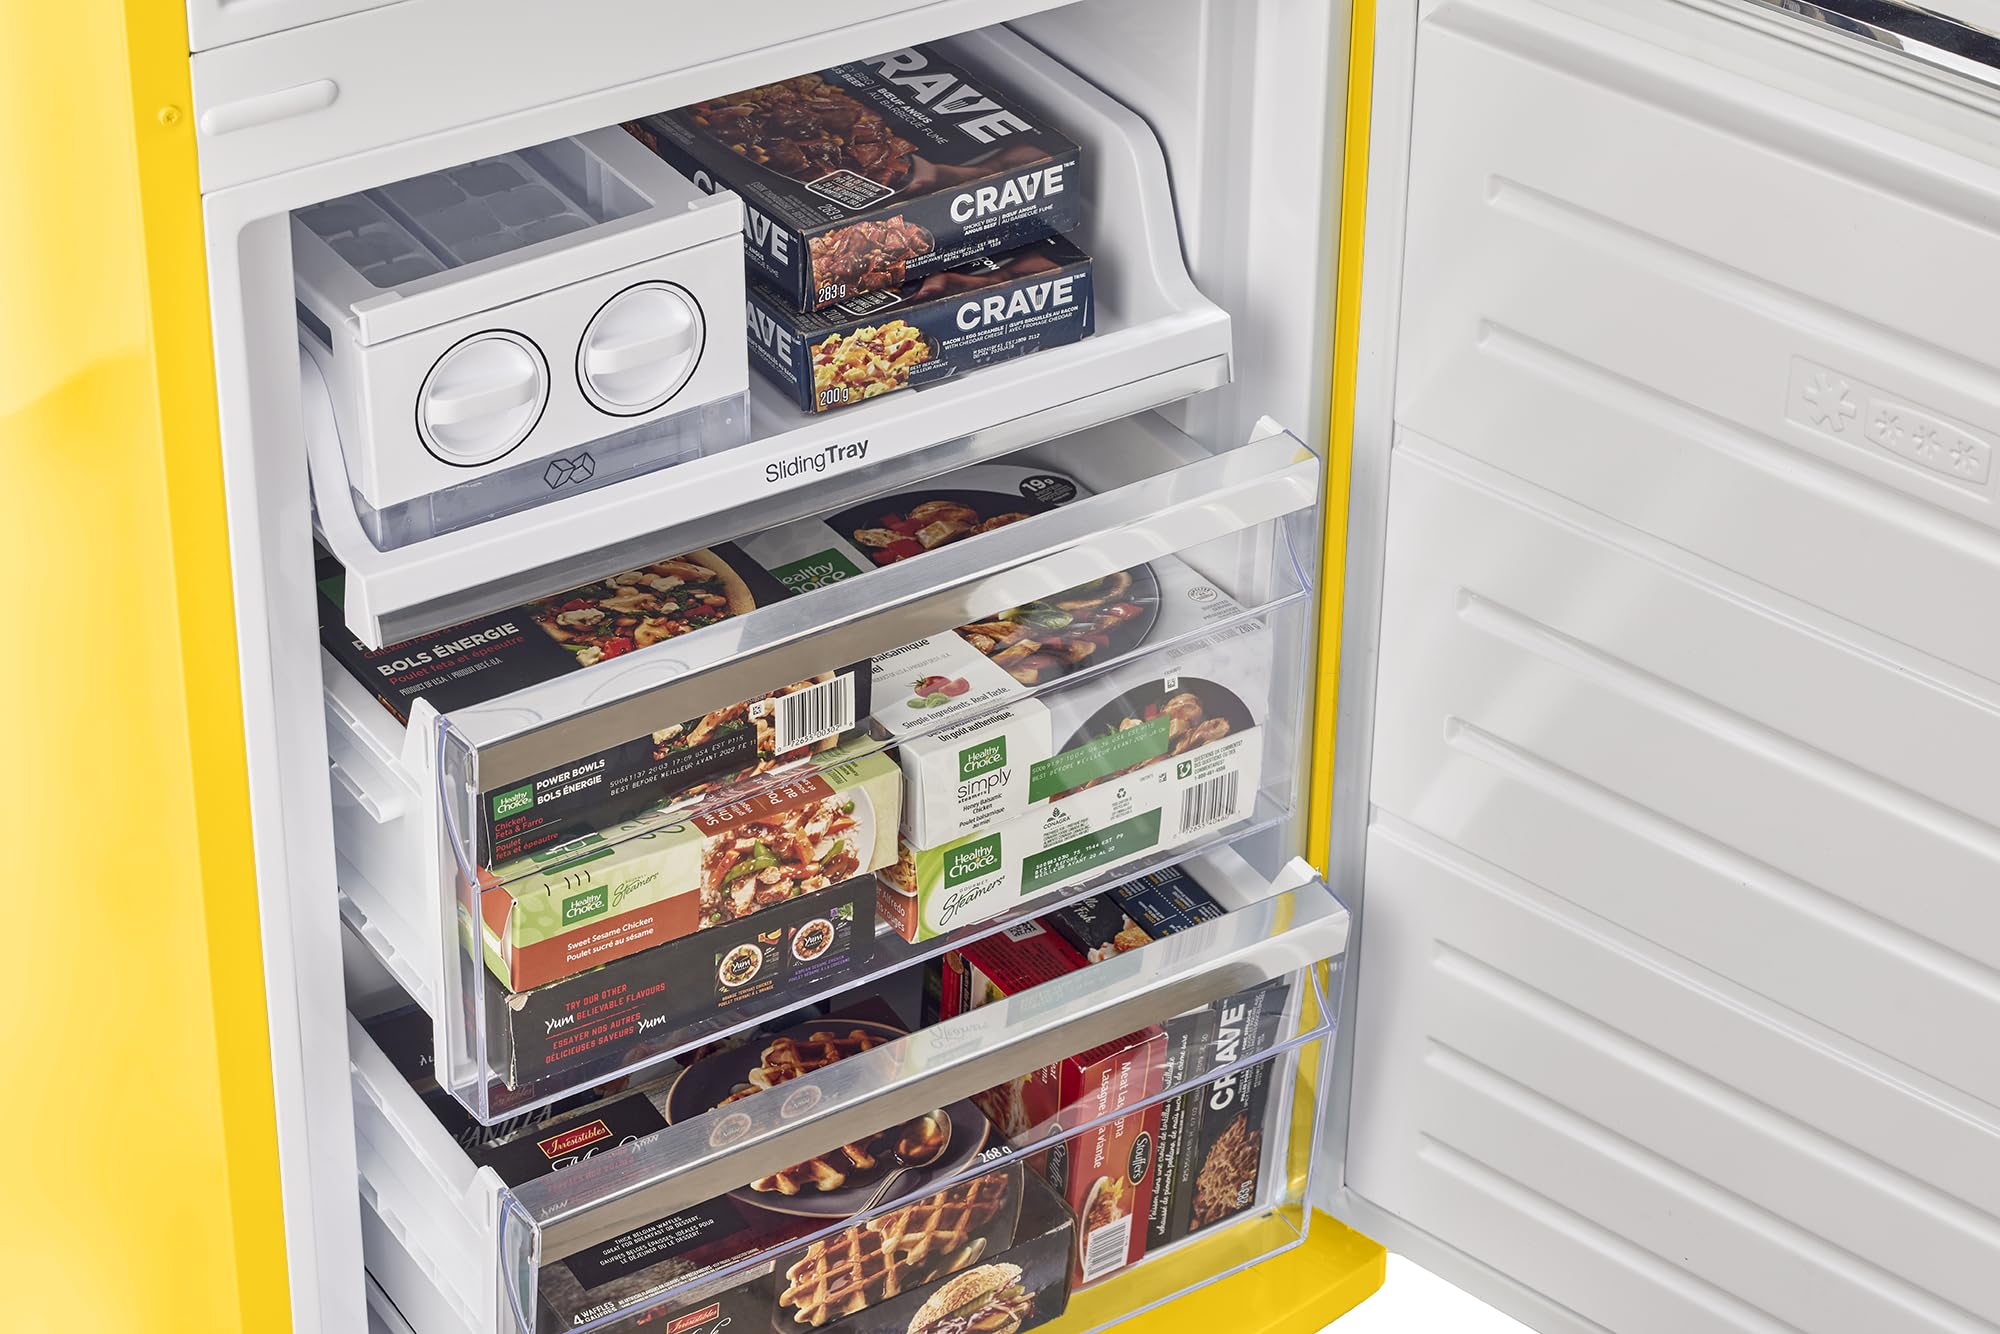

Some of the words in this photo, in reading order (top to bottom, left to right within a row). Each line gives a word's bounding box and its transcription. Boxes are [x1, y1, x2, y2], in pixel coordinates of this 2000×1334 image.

[841, 73, 867, 90] BEEF
[900, 104, 933, 125] ANGUS
[950, 164, 1064, 223] CRAVE
[818, 285, 837, 303] 283
[956, 276, 1074, 331] CRAVE
[942, 337, 961, 347] BACON
[965, 334, 977, 343] EGG
[820, 388, 840, 407] 200
[765, 439, 869, 483] SlidingTray
[376, 651, 433, 677] BOLS
[432, 622, 520, 660] ÉNERGIE
[388, 668, 430, 686] Poulet
[431, 660, 456, 674] feta
[457, 655, 471, 665] et
[471, 634, 526, 659] épeautre
[400, 682, 426, 697] PRODUCT
[902, 713, 929, 730] Simple
[929, 700, 973, 722] Ingredients.
[971, 693, 989, 706] Real
[989, 686, 1011, 699] Taste.
[938, 733, 947, 743] Un
[949, 726, 969, 741] goût
[711, 741, 726, 753] EST
[967, 745, 1000, 764] Healthy
[963, 753, 1001, 773] Choice
[536, 772, 570, 791] POWER
[572, 759, 606, 778] BOWLS
[610, 784, 630, 797] BEST
[632, 775, 659, 791] BEFORE
[957, 768, 1012, 799] simply
[500, 791, 528, 805] Healthy
[537, 790, 562, 805] BOLS
[563, 775, 602, 796] ÉNERGIE
[497, 797, 529, 814] Choice
[963, 802, 980, 812] Honey
[980, 793, 1003, 807] Balsamic
[972, 803, 993, 815] Chicken
[495, 816, 526, 833] Chicken
[495, 828, 513, 840] Feta
[522, 817, 544, 830] Farro
[959, 817, 976, 828] Poulet
[976, 807, 1005, 821] balsamique
[1043, 816, 1070, 830] CONAGRA
[495, 838, 521, 853] Poulet
[495, 849, 512, 861] feta
[523, 832, 559, 850] épeautre
[955, 845, 993, 866] Healthy
[949, 854, 994, 878] Choice
[571, 893, 602, 910] Healthy
[612, 873, 656, 908] Steamers
[939, 878, 1000, 926] Steamers
[566, 902, 603, 919] Choice
[1074, 904, 1097, 924] Fish
[566, 947, 591, 963] Poulet
[592, 939, 614, 954] sucré
[615, 937, 625, 946] au
[625, 926, 654, 943] sésame
[567, 939, 590, 952] Sweet
[591, 927, 621, 944] Sesame
[622, 916, 653, 932] Chicken
[803, 933, 823, 946] Yum
[544, 1014, 575, 1035] Yum
[626, 982, 666, 1003] FLAVOURS
[565, 999, 581, 1012] TRY
[583, 993, 600, 1006] OUR
[601, 983, 628, 999] OTHER
[545, 1039, 597, 1064] DÉLICIEUSES
[598, 1025, 635, 1046] SAVEURS
[637, 1014, 666, 1034] Yum
[553, 1032, 590, 1050] ESSAYER
[591, 1024, 608, 1035] NOS
[610, 1012, 641, 1030] AUTRES
[1120, 1061, 1132, 1090] Meat
[1097, 1068, 1113, 1111] Lasagne
[547, 1126, 607, 1155] Irresistibles
[1158, 1131, 1168, 1142] de
[977, 1147, 1002, 1164] 268
[1093, 1136, 1106, 1169] viande
[1131, 1137, 1149, 1180] Stouffer's
[599, 1253, 626, 1266] GAUFRES
[625, 1244, 648, 1256] BELGES
[676, 1226, 699, 1237] IDÉALES
[699, 1218, 715, 1229] POUR
[602, 1246, 621, 1256] GREAT
[621, 1241, 634, 1249] FOR
[633, 1229, 665, 1244] BREAKFAST
[675, 1215, 702, 1229] DESSERT.
[614, 1235, 632, 1245] THICK
[632, 1226, 657, 1239] BELGIAN
[657, 1216, 682, 1228] WAFFLES
[658, 1243, 668, 1251] OU
[668, 1239, 676, 1247] LE
[676, 1230, 702, 1244] DESSERT.
[573, 1314, 585, 1326] 4
[581, 1301, 615, 1318] WAFFLES
[584, 1307, 618, 1323] GAUFRES
